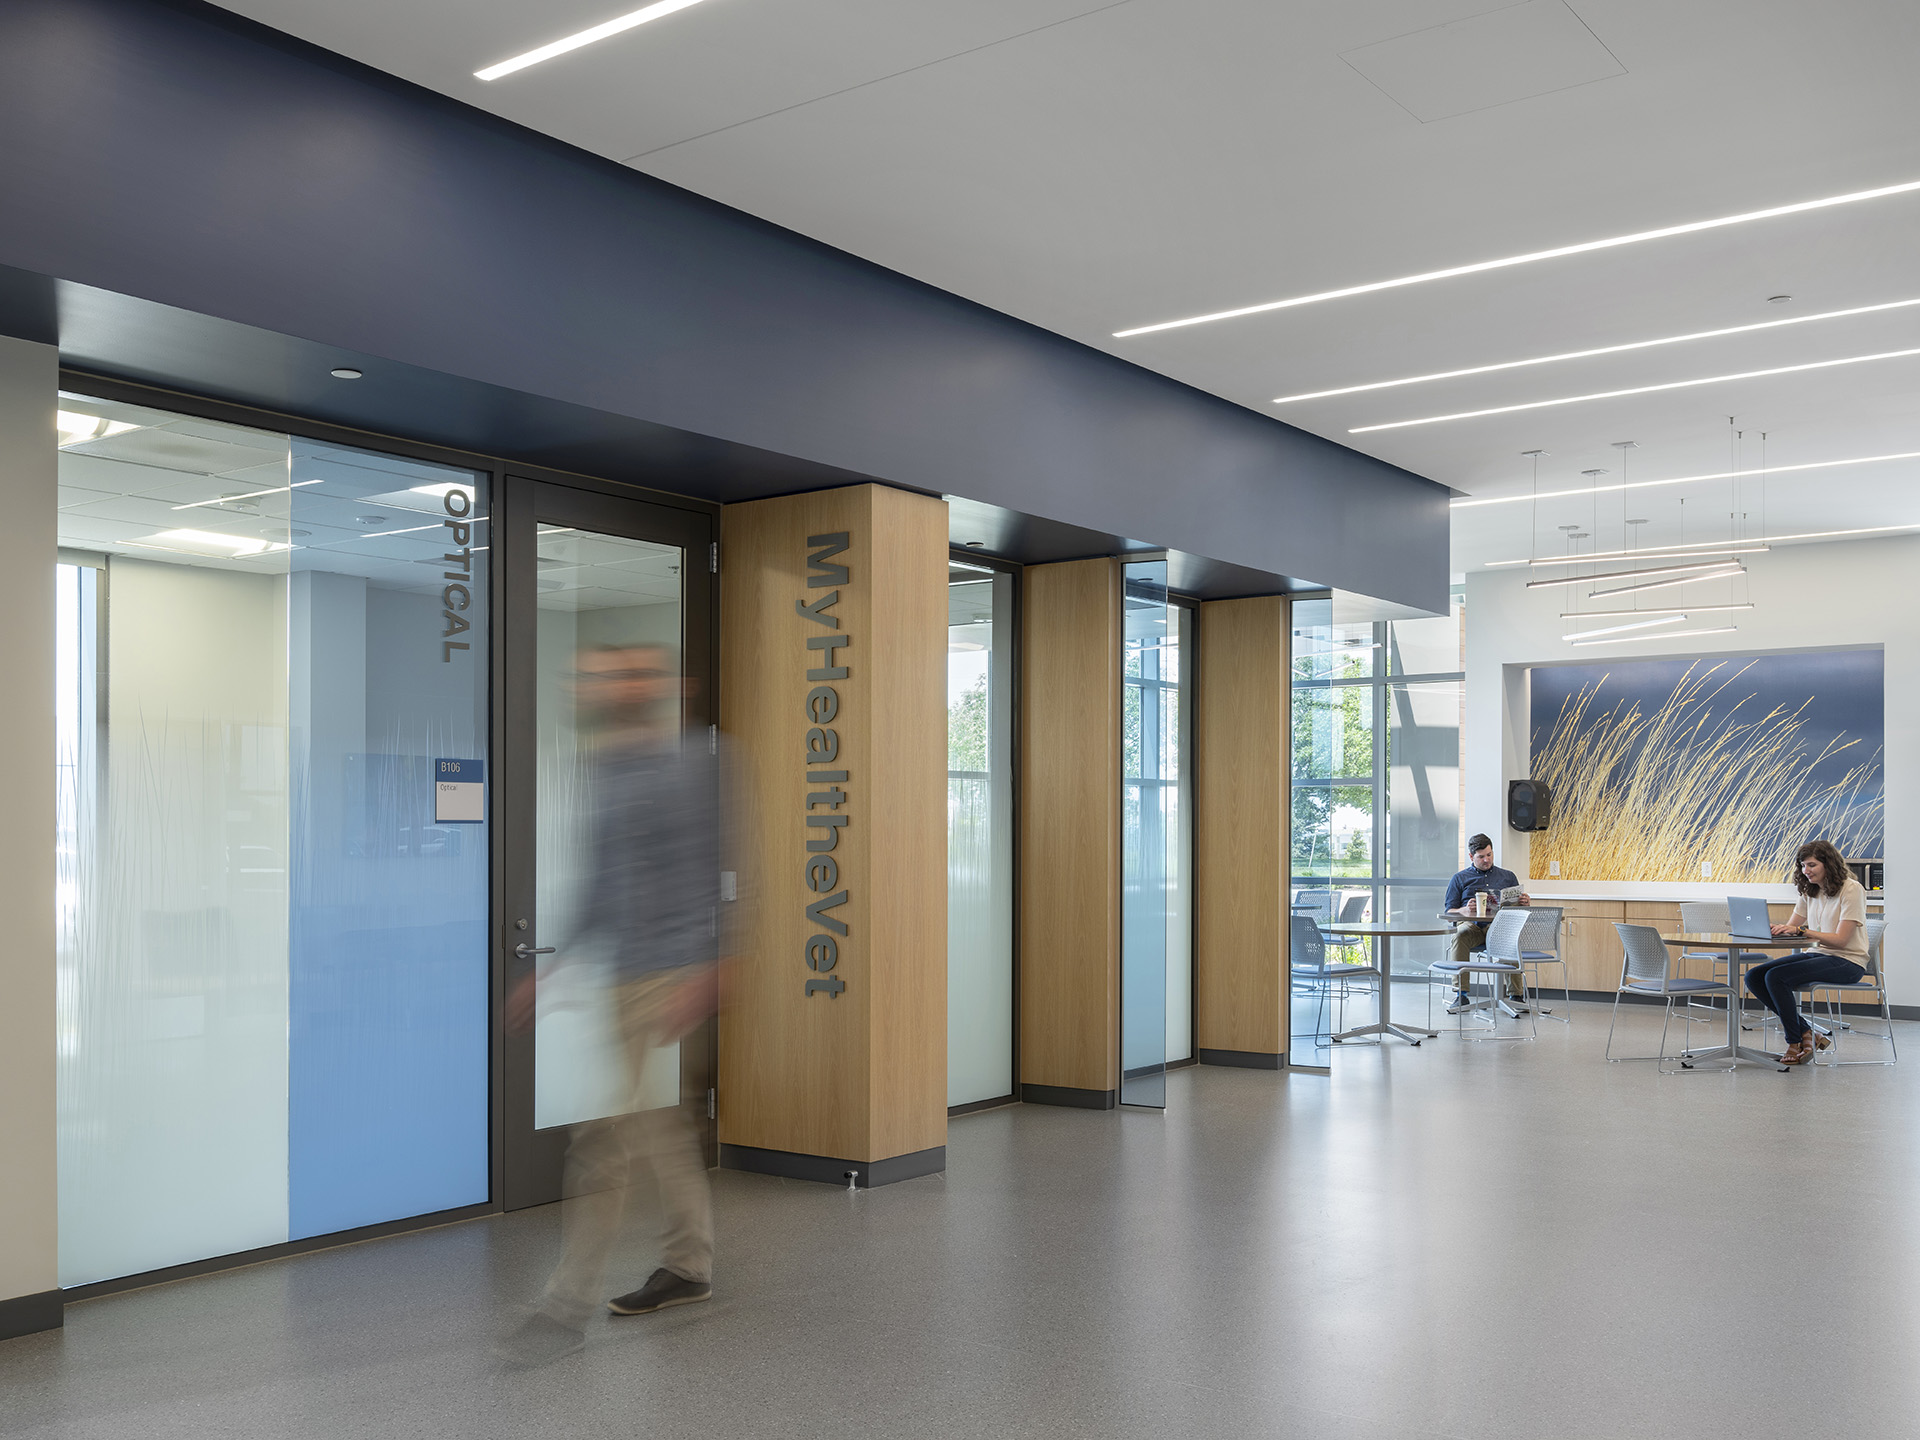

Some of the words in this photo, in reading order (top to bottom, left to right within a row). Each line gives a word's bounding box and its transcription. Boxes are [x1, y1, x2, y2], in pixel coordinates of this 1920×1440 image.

[444, 489, 471, 662] OPTICAL
[441, 761, 461, 773] B106
[795, 531, 850, 998] MyHealtheVet
